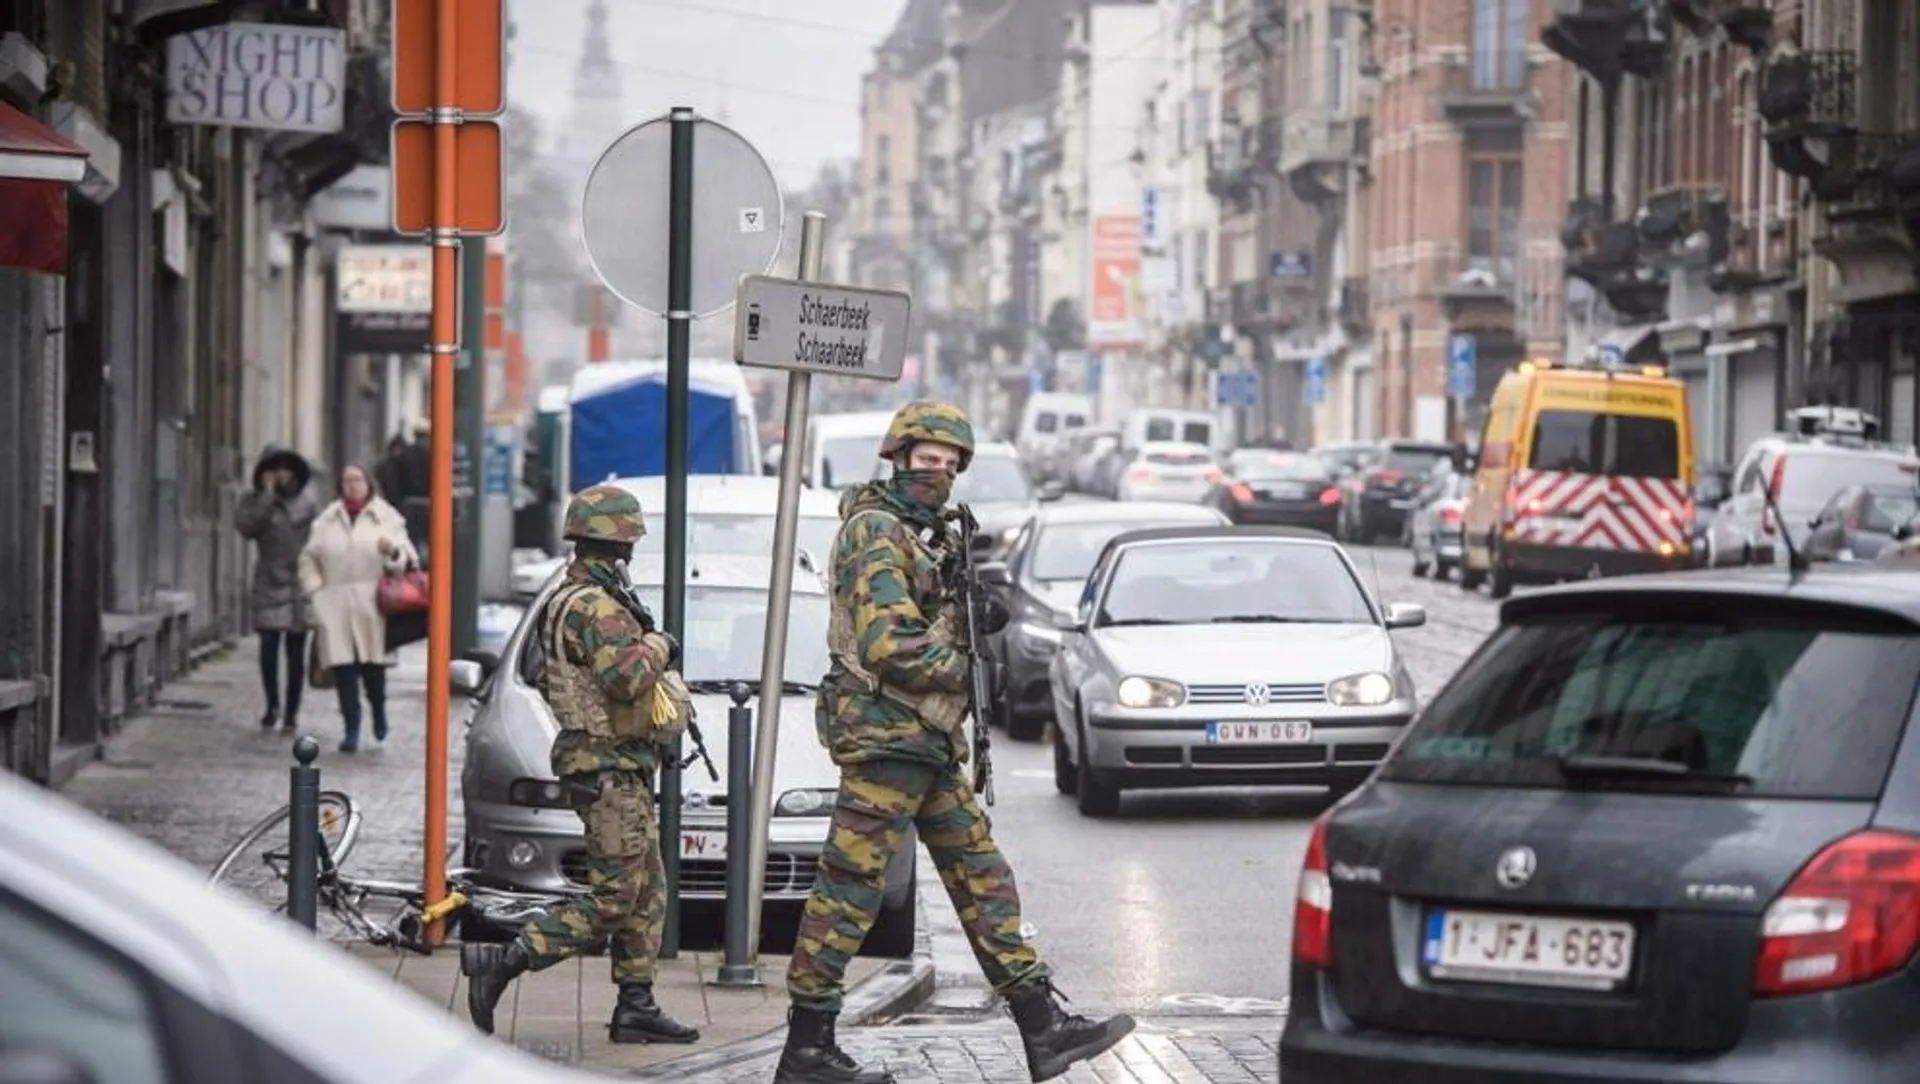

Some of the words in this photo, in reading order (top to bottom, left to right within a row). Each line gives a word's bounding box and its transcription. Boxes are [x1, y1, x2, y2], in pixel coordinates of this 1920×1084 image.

[181, 30, 336, 79] NIGHT
[180, 72, 336, 125] SHOP
[799, 293, 870, 330] Schaerbeek
[795, 331, 867, 368] Schaarbeek
